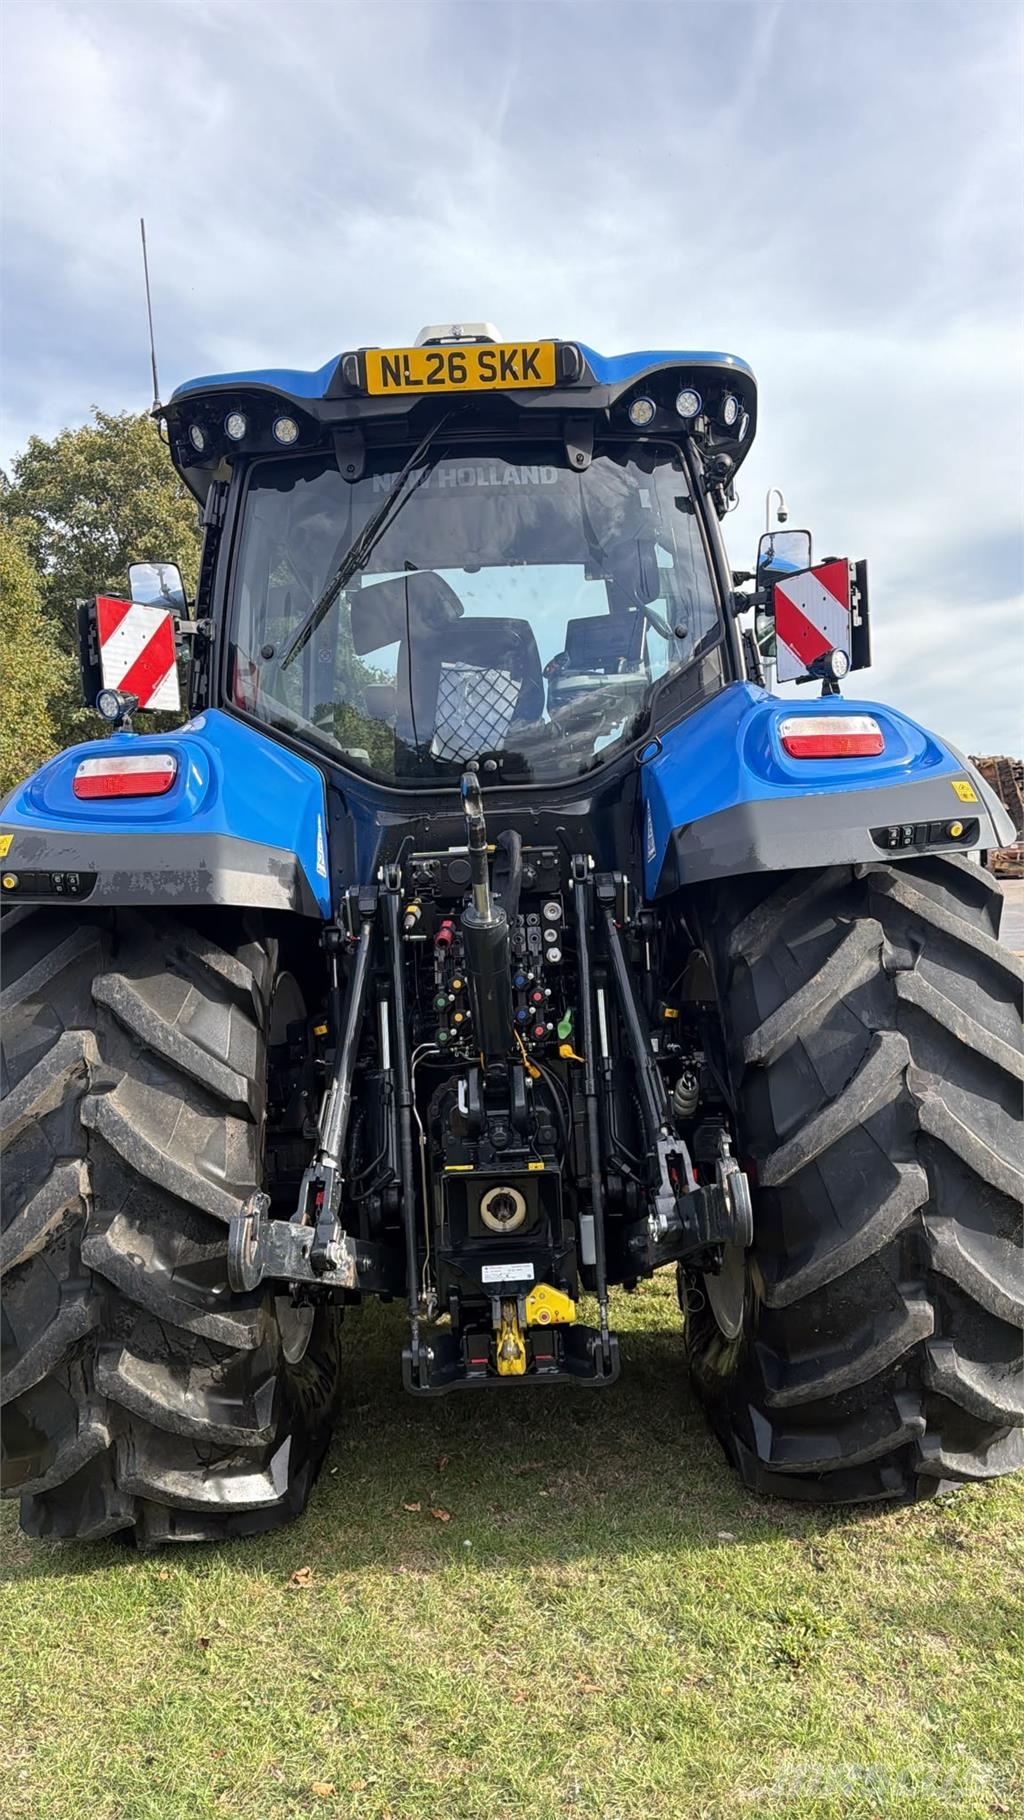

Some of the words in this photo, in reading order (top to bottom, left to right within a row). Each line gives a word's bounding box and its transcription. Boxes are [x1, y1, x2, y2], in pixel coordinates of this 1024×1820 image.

[381, 351, 467, 387] NL26
[478, 348, 542, 382] SKK
[372, 469, 431, 492] NW
[438, 465, 559, 488] HOLLAND
